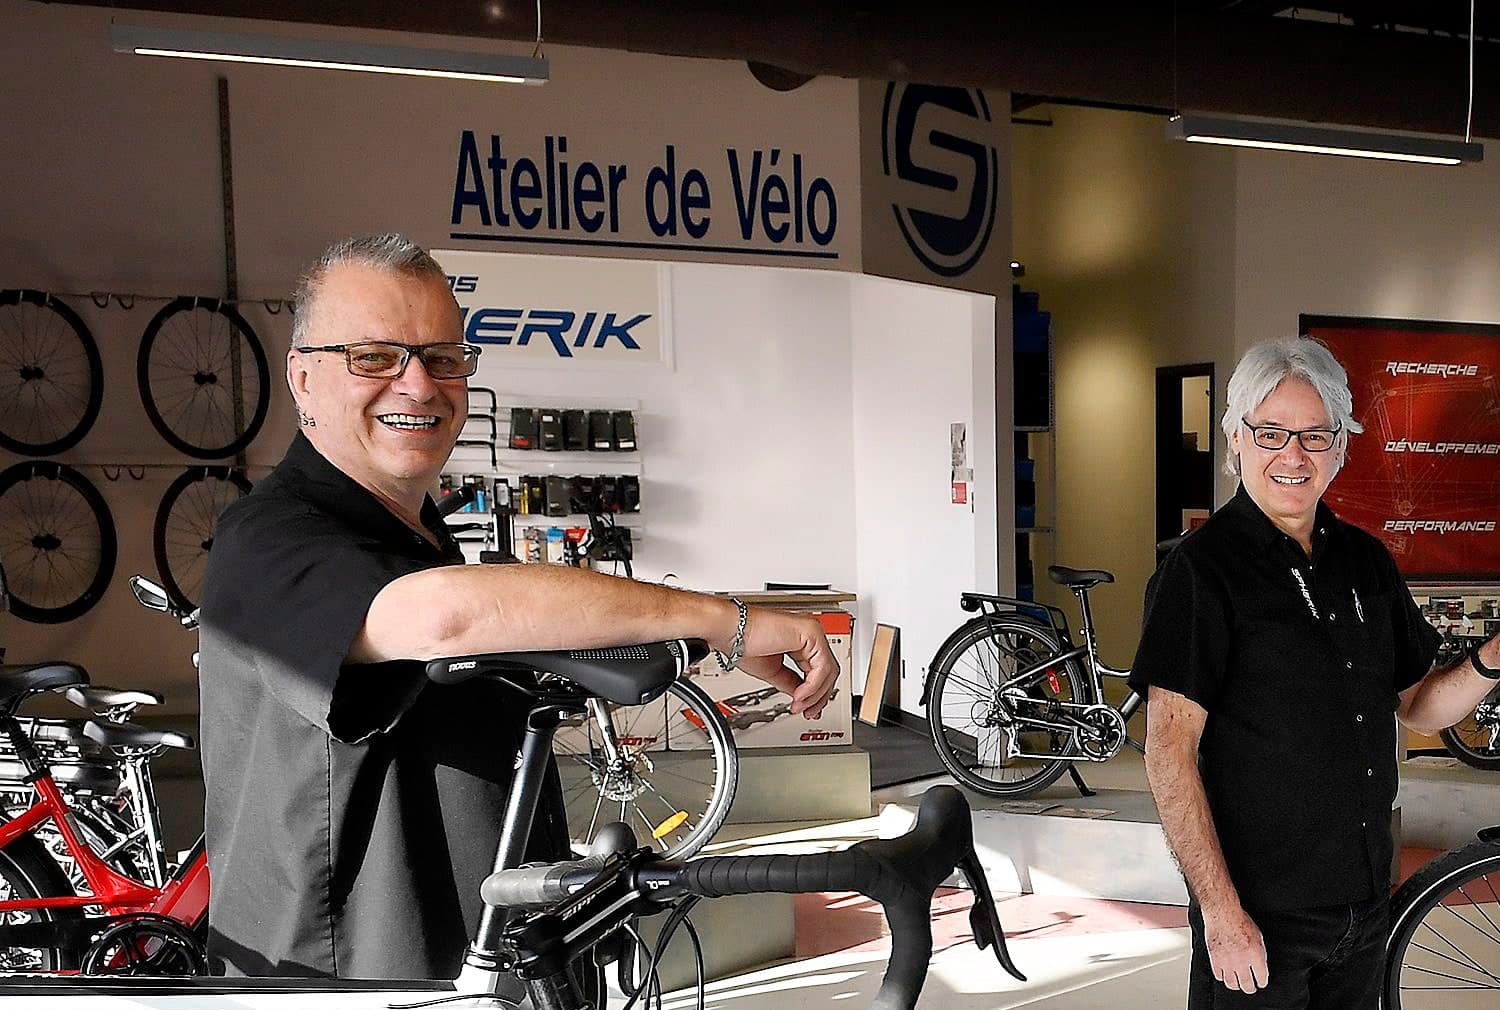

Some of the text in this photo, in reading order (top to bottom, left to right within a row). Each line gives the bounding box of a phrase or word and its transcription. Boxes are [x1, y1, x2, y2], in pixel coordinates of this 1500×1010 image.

[451, 130, 838, 246] Atelier de Vélo
[462, 307, 652, 357] ERIK
[1386, 361, 1478, 378] RECHERCHE
[1384, 520, 1496, 534] PERFORMANCE
